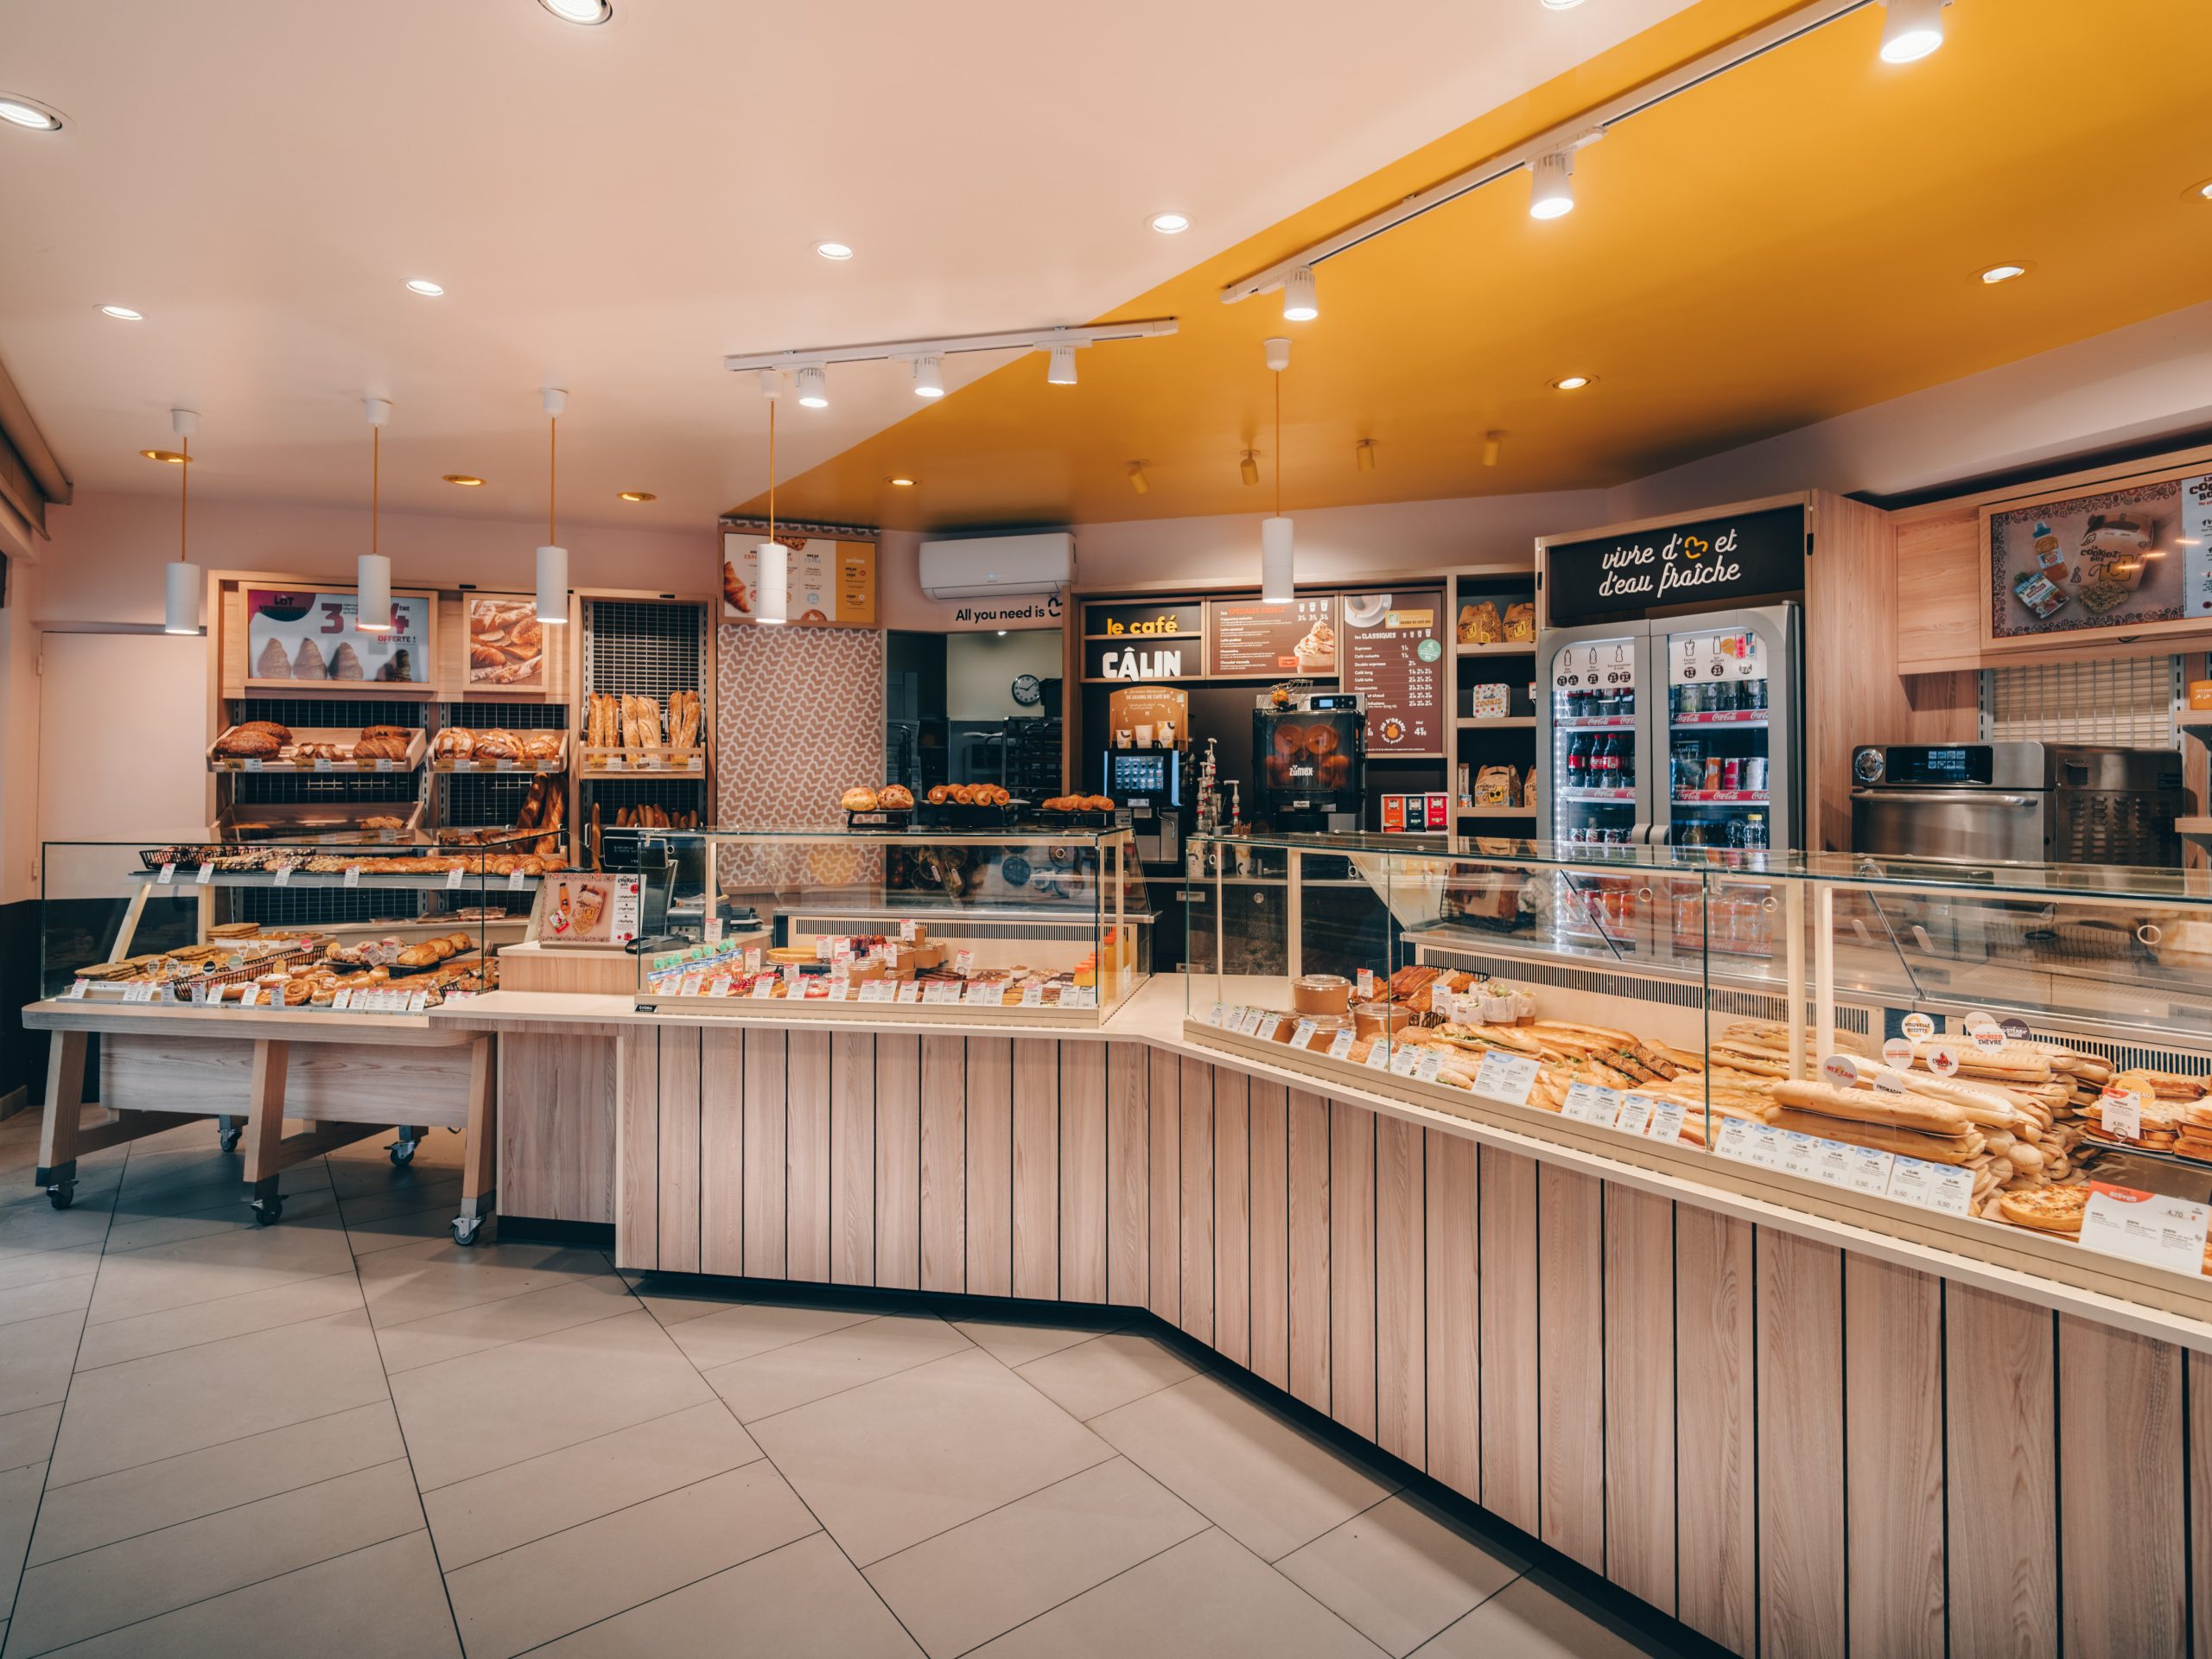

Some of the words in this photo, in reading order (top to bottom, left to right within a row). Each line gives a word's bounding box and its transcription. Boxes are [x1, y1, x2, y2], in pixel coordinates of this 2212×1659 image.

[1602, 545, 1655, 569] vivre
[1662, 533, 1683, 560] d'
[1715, 529, 1738, 553] et
[1599, 571, 1654, 596] d'eau
[1657, 555, 1742, 599] fraîche
[321, 602, 344, 634] 3
[391, 602, 410, 634] 4
[956, 608, 971, 621] All
[974, 611, 996, 624] you
[1000, 606, 1032, 619] need
[1035, 606, 1045, 617] is
[1107, 618, 1124, 635] le
[1130, 615, 1178, 635] café
[1103, 646, 1181, 682] CÂLIN
